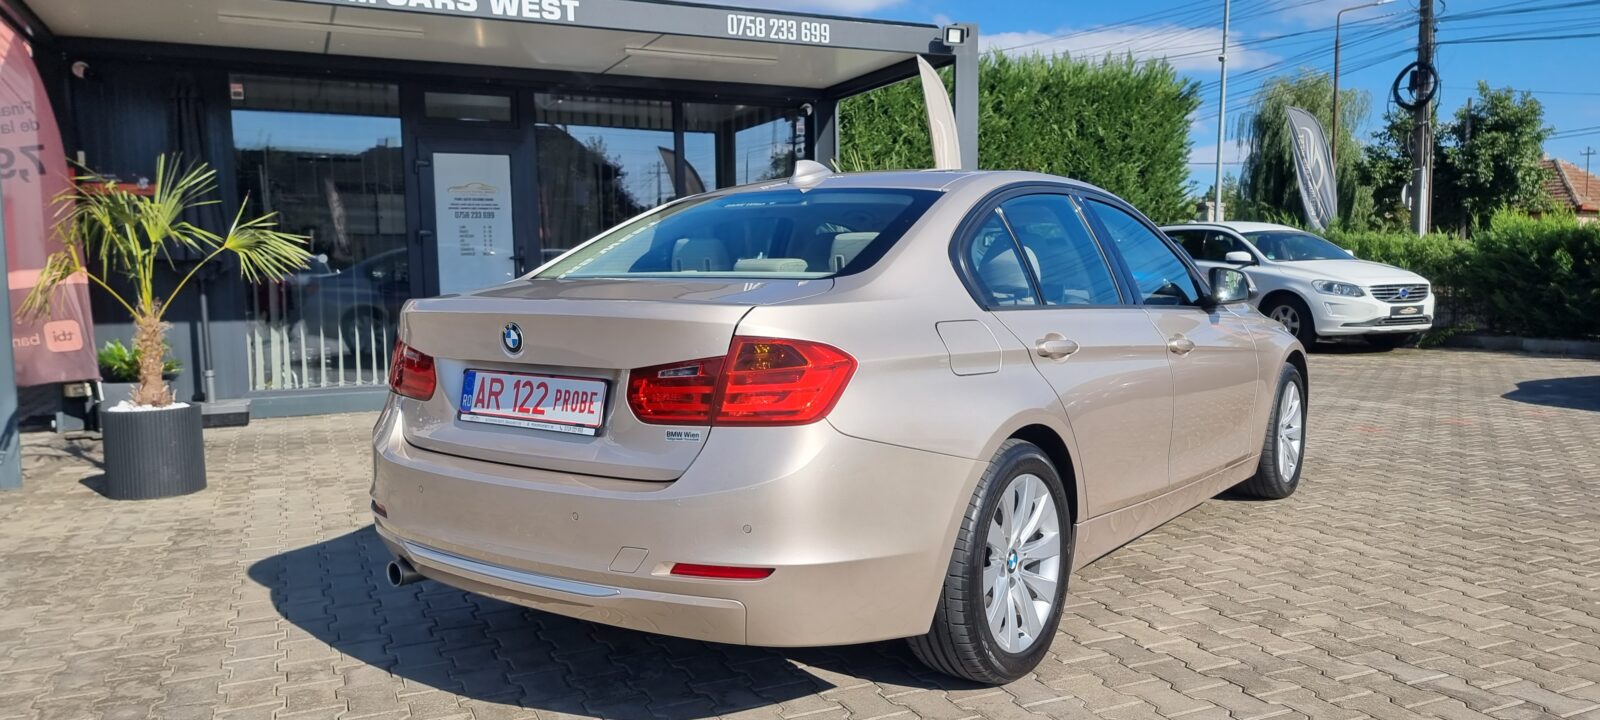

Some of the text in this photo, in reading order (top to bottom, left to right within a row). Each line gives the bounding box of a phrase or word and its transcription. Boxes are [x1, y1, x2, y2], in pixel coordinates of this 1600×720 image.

[490, 0, 580, 22] WEST
[727, 14, 830, 44] 0758 233 699
[462, 394, 473, 407] RO
[474, 376, 598, 415] AR 122 PROBE
[666, 430, 700, 439] BMW Wien
